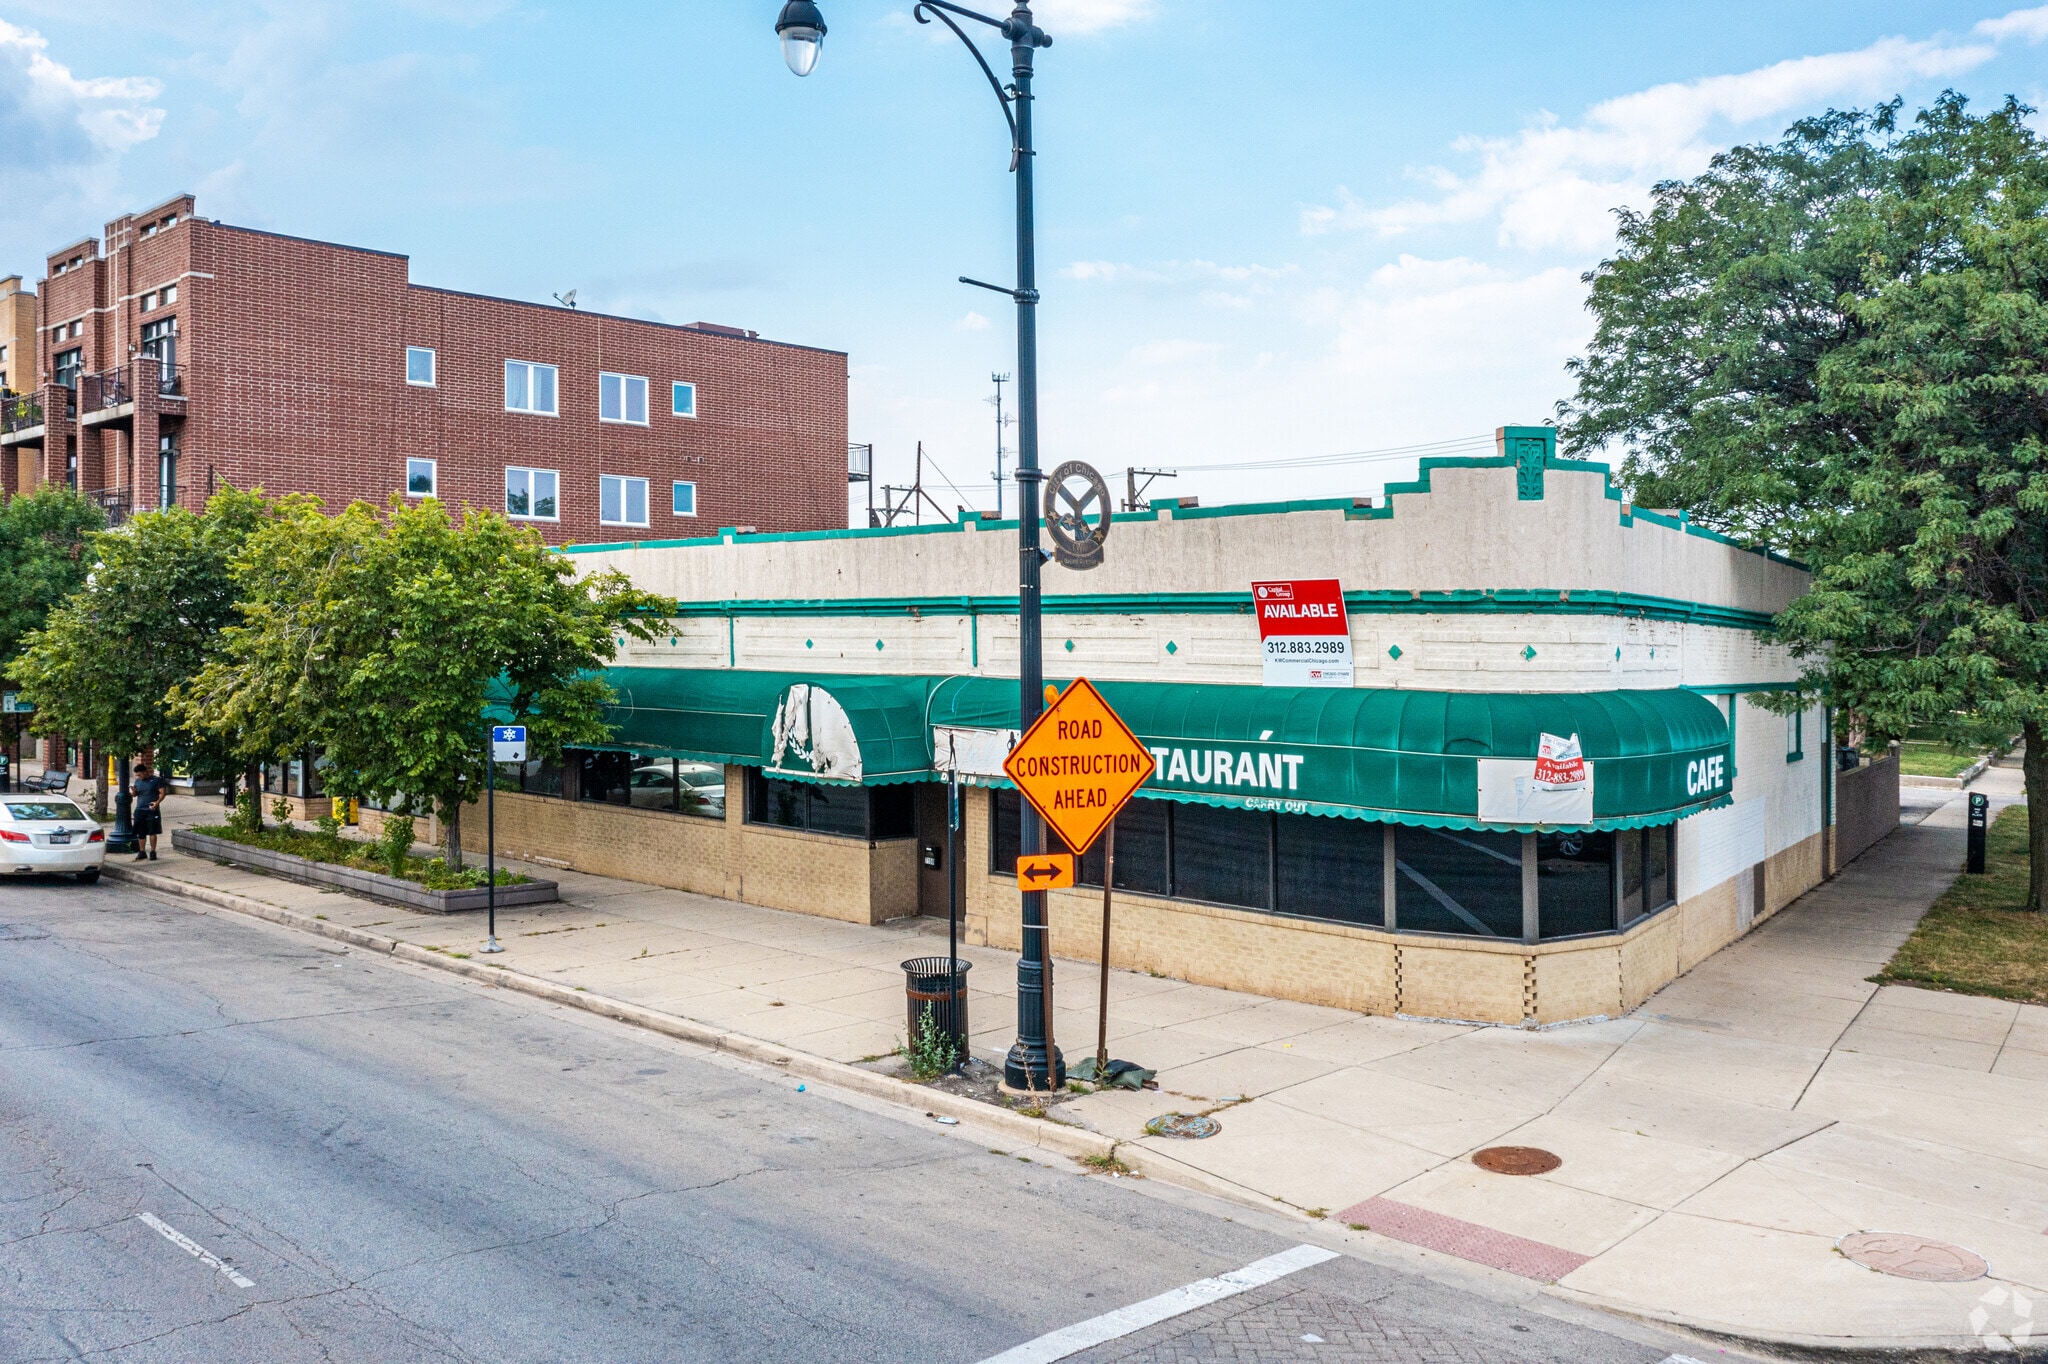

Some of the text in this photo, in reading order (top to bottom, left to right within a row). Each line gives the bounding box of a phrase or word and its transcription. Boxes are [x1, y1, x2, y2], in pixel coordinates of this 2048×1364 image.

[1048, 463, 1106, 496] City of Chicago
[1264, 603, 1338, 618] AVAILABLE
[1268, 641, 1345, 654] 312.883.2989
[1058, 719, 1102, 740] ROAD
[1016, 753, 1141, 778] CONSTRUCTION
[1143, 746, 1304, 790] TAURANT
[1544, 761, 1579, 770] Available
[940, 772, 977, 784] DE IN
[1536, 768, 1584, 783] 312-883-2989
[1687, 754, 1724, 796] CAFE
[1053, 788, 1107, 810] AHEAD
[1245, 797, 1309, 813] CARRY OUT
